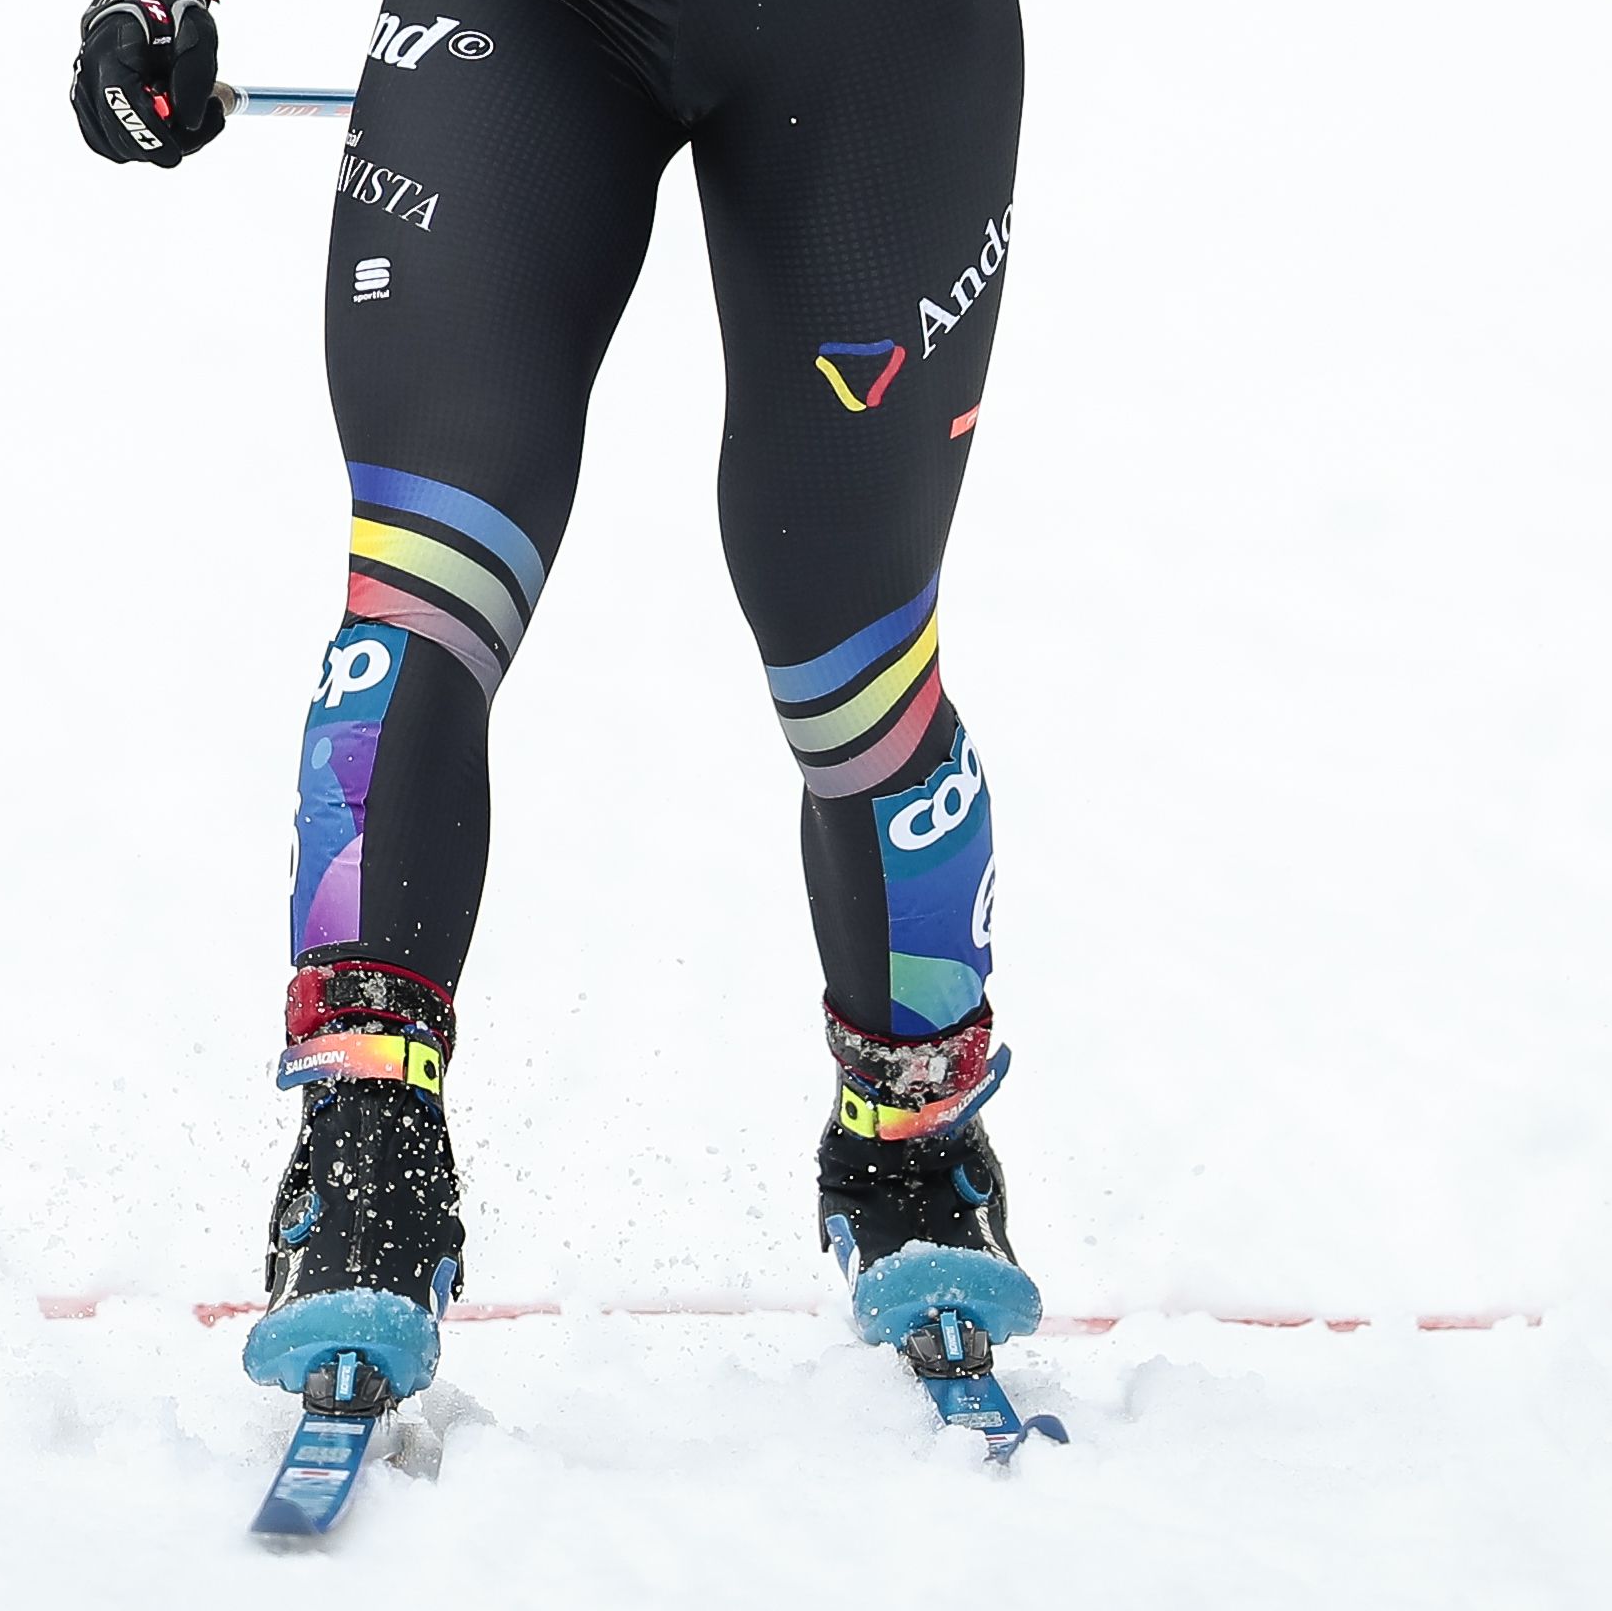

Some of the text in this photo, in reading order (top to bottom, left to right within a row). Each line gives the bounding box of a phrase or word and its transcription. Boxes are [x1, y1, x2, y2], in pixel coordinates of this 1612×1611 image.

[104, 87, 163, 151] KV+
[338, 154, 440, 232] VISTA
[285, 1051, 346, 1076] SALOMON
